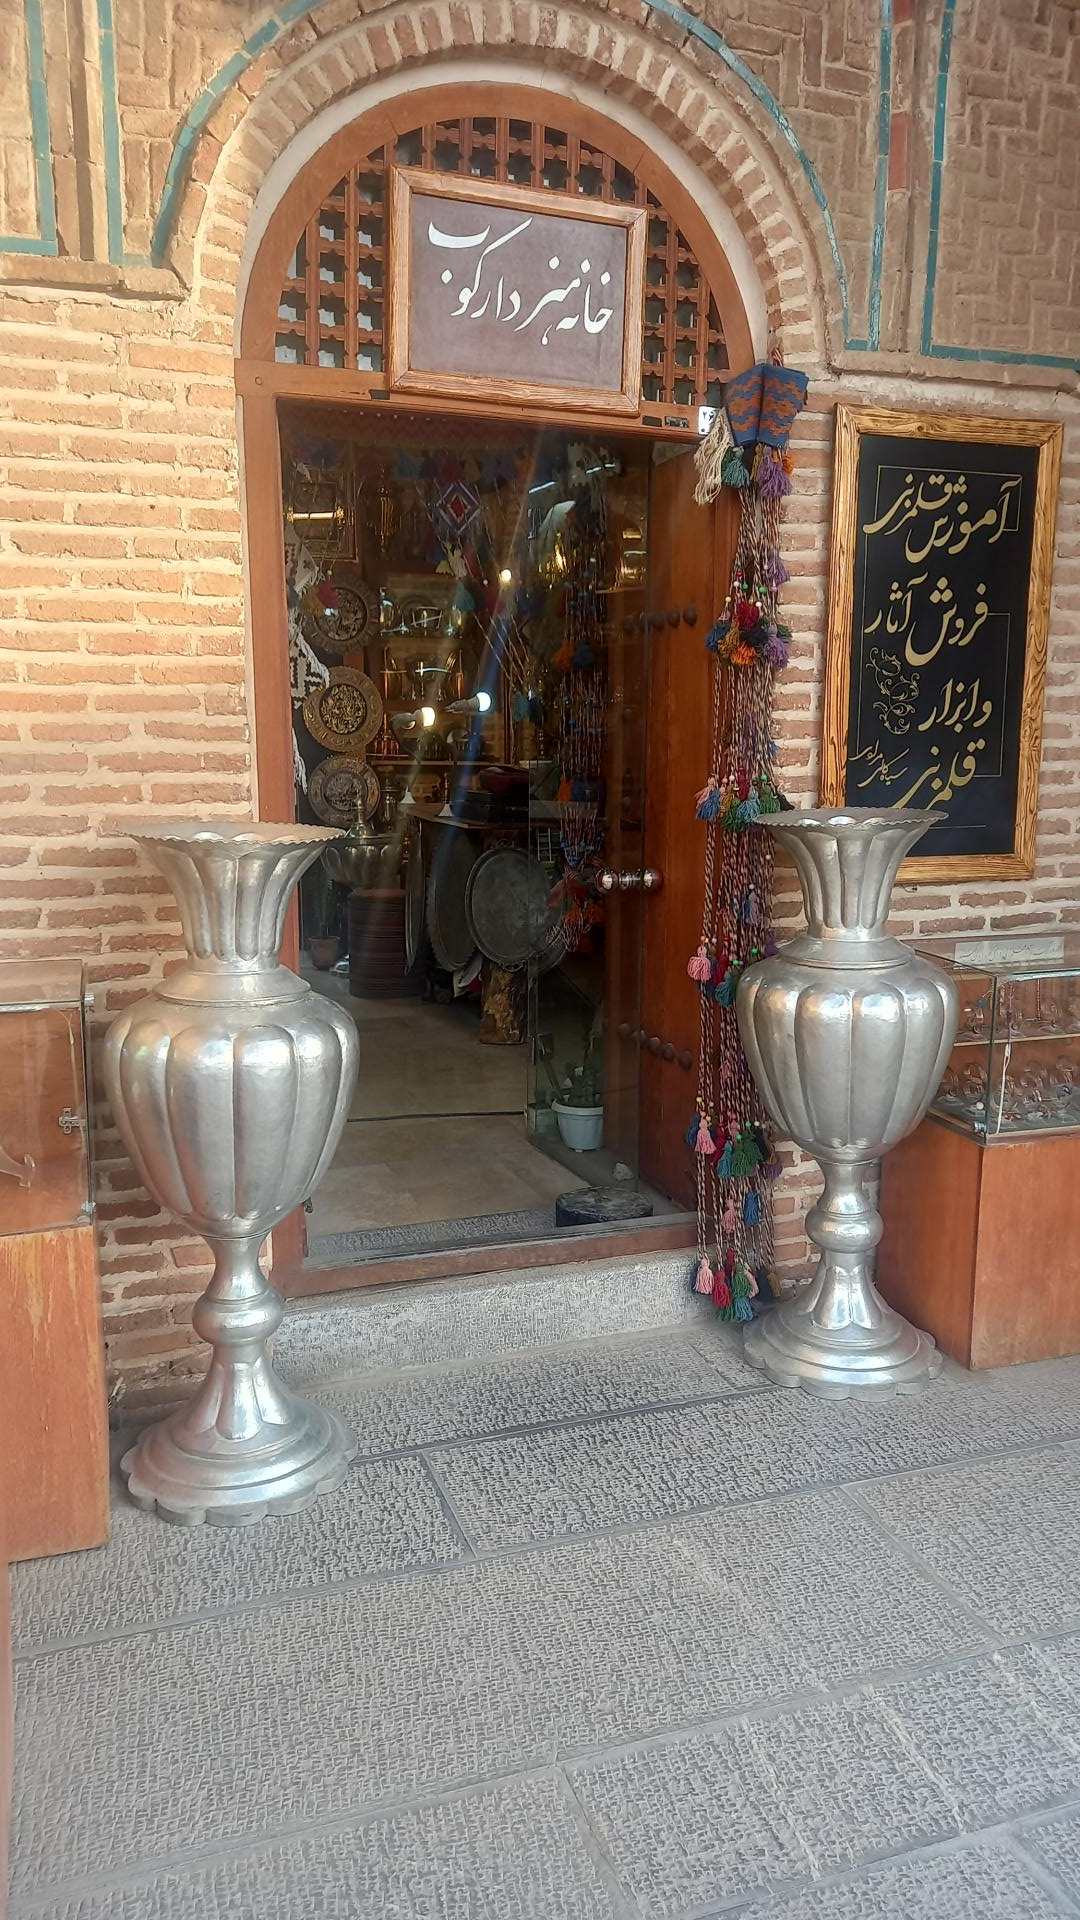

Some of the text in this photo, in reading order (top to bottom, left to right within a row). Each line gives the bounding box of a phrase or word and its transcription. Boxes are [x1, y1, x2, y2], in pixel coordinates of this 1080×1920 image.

[428, 217, 533, 321] دارکوب
[905, 474, 1022, 563] آموزش
[864, 572, 988, 666] فروش آثار
